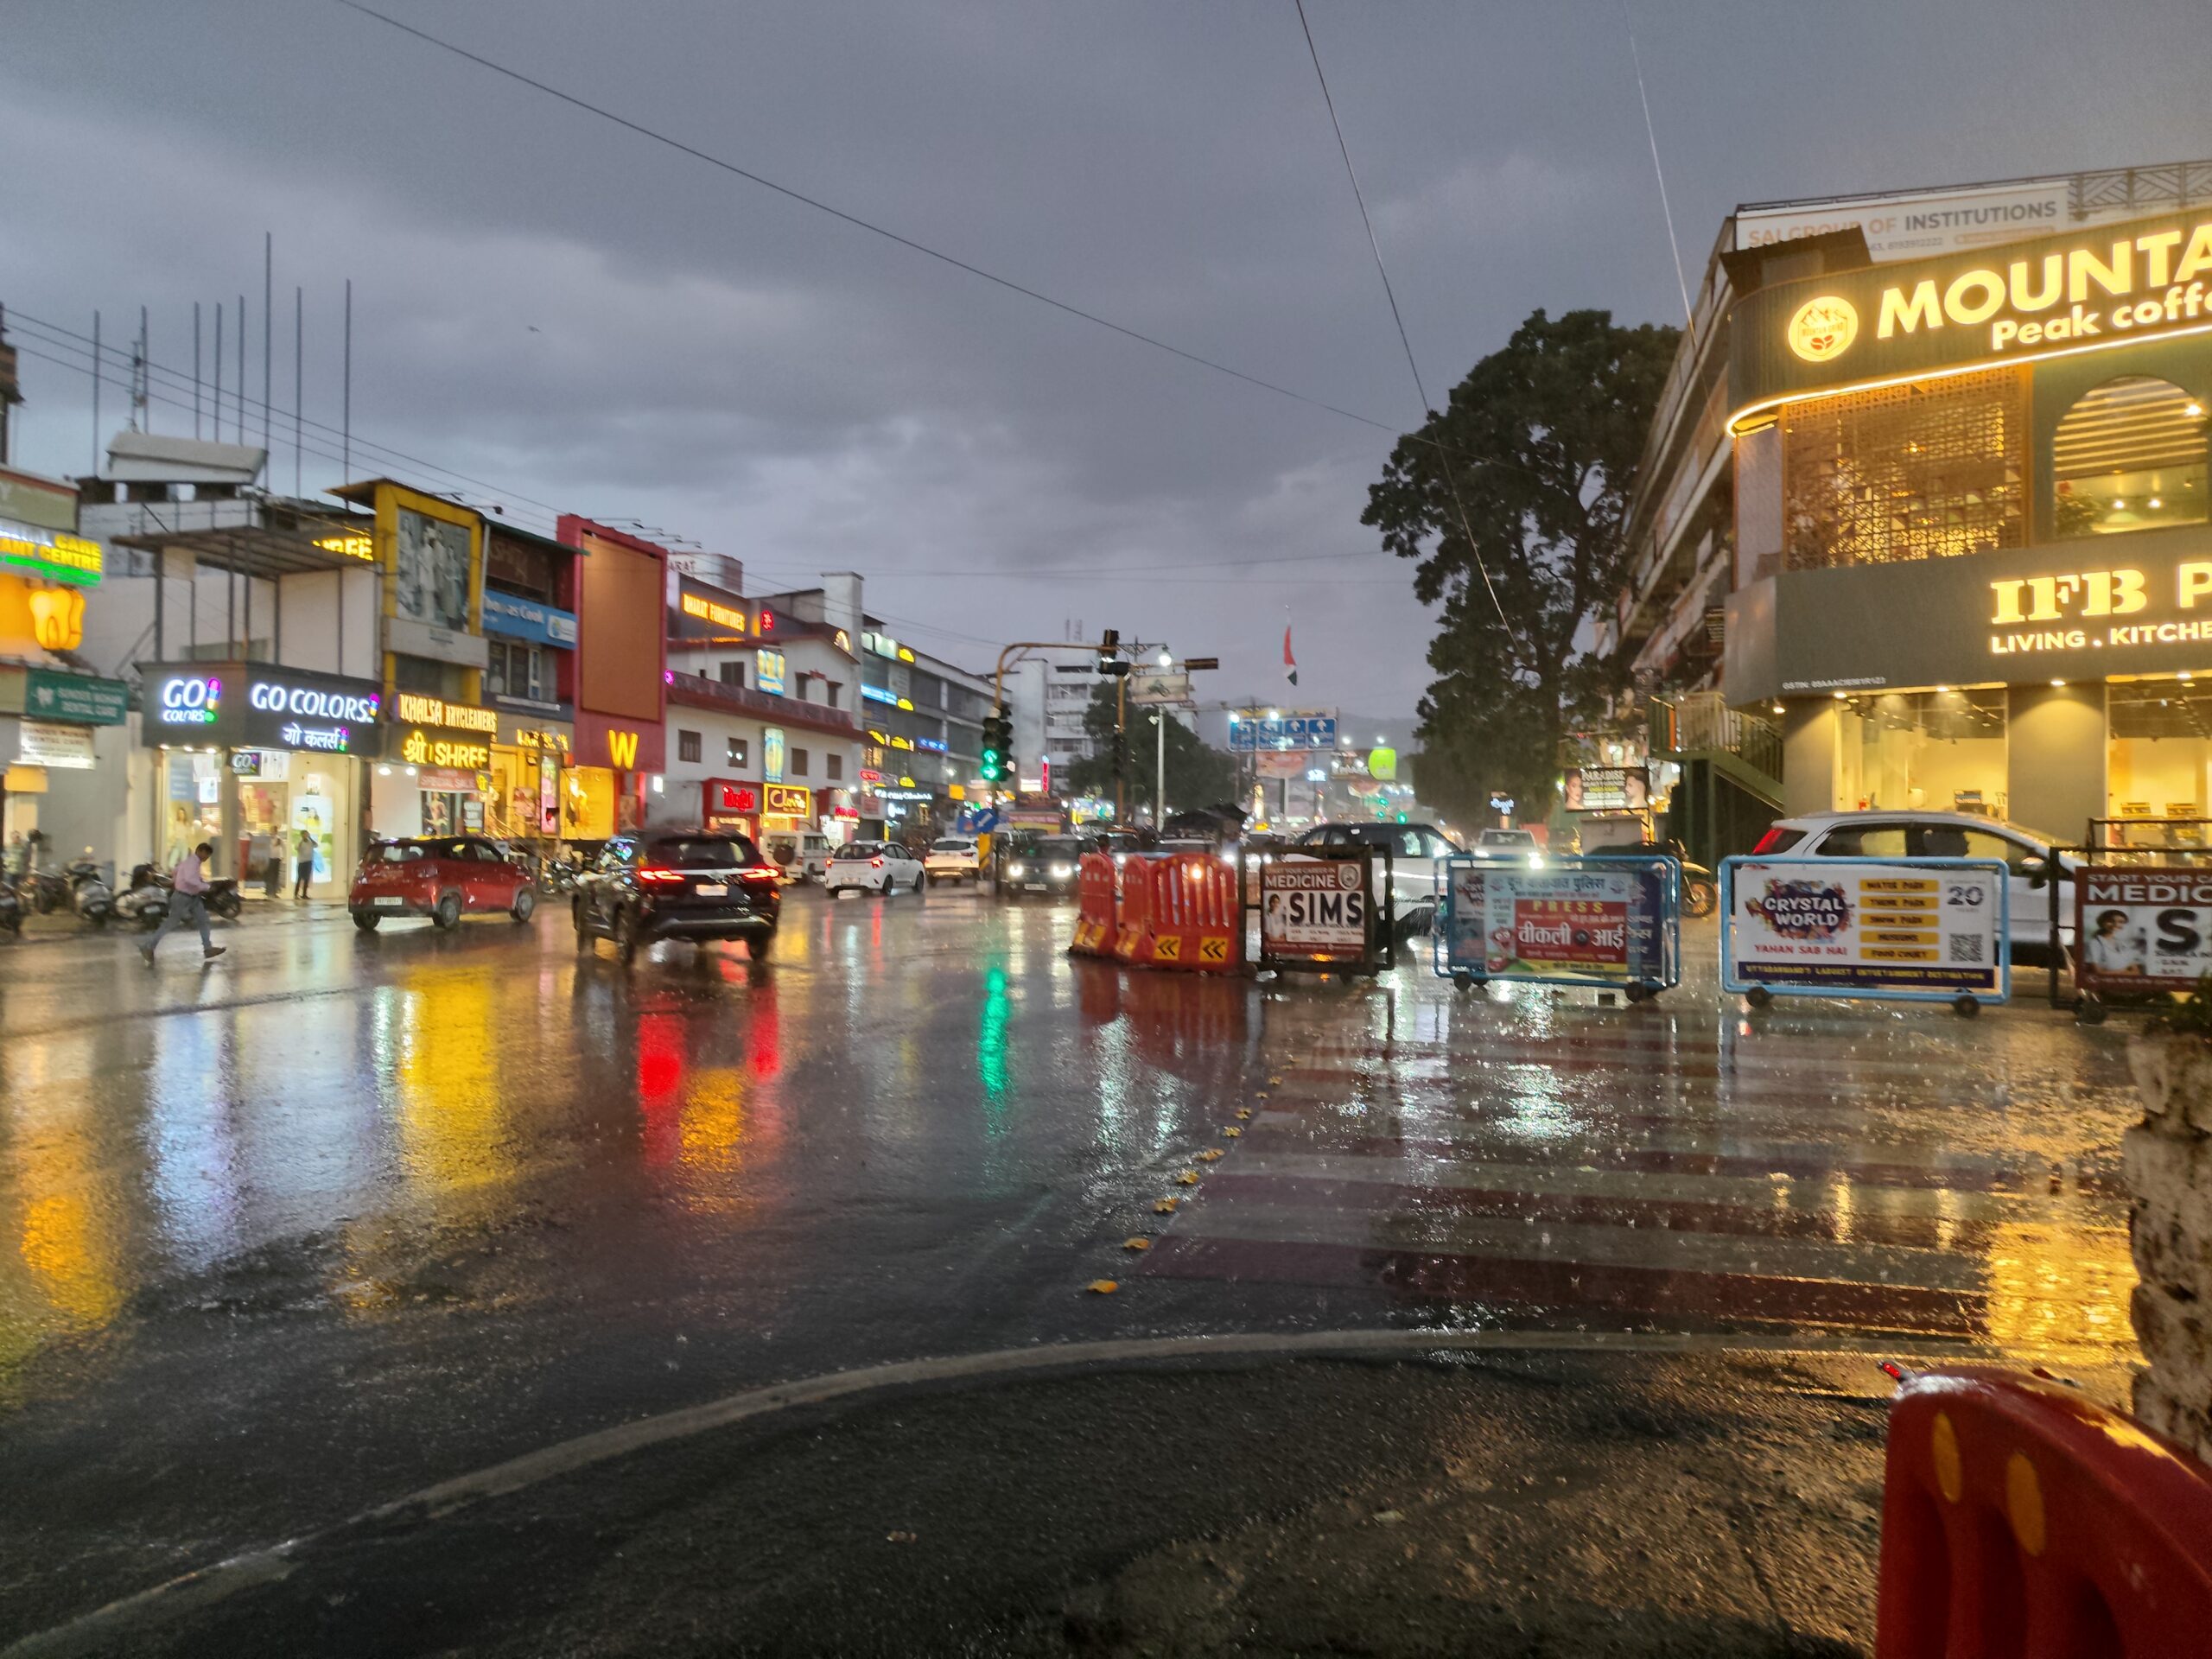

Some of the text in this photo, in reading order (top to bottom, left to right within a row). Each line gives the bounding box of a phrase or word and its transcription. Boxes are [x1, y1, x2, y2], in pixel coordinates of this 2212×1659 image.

[1868, 216, 1897, 235] OF
[1904, 200, 2057, 232] INSTITUTIONS
[1992, 304, 2101, 350] Peak
[38, 544, 102, 574] CENTRE
[54, 533, 102, 559] CARE
[683, 593, 709, 620] BHARAT
[1989, 569, 2148, 625] IFB
[1992, 630, 2086, 654] LIVING
[251, 683, 287, 712] GO
[399, 694, 443, 727] KHALSA
[162, 709, 206, 722] COLORS
[608, 729, 639, 770] W
[1264, 874, 1337, 889] MEDICINE
[2088, 874, 2140, 883] START
[2144, 874, 2193, 884] YOUR
[1289, 892, 1363, 926] SIMS
[1532, 899, 1605, 914] PRESS
[1764, 897, 1844, 912] CRYSTAL
[1947, 886, 1985, 906] 20
[1775, 913, 1840, 927] WORLD
[1517, 920, 1572, 947] वीकली
[1591, 924, 1625, 951] आई
[1755, 944, 1848, 956] YAHAN SAB HAI
